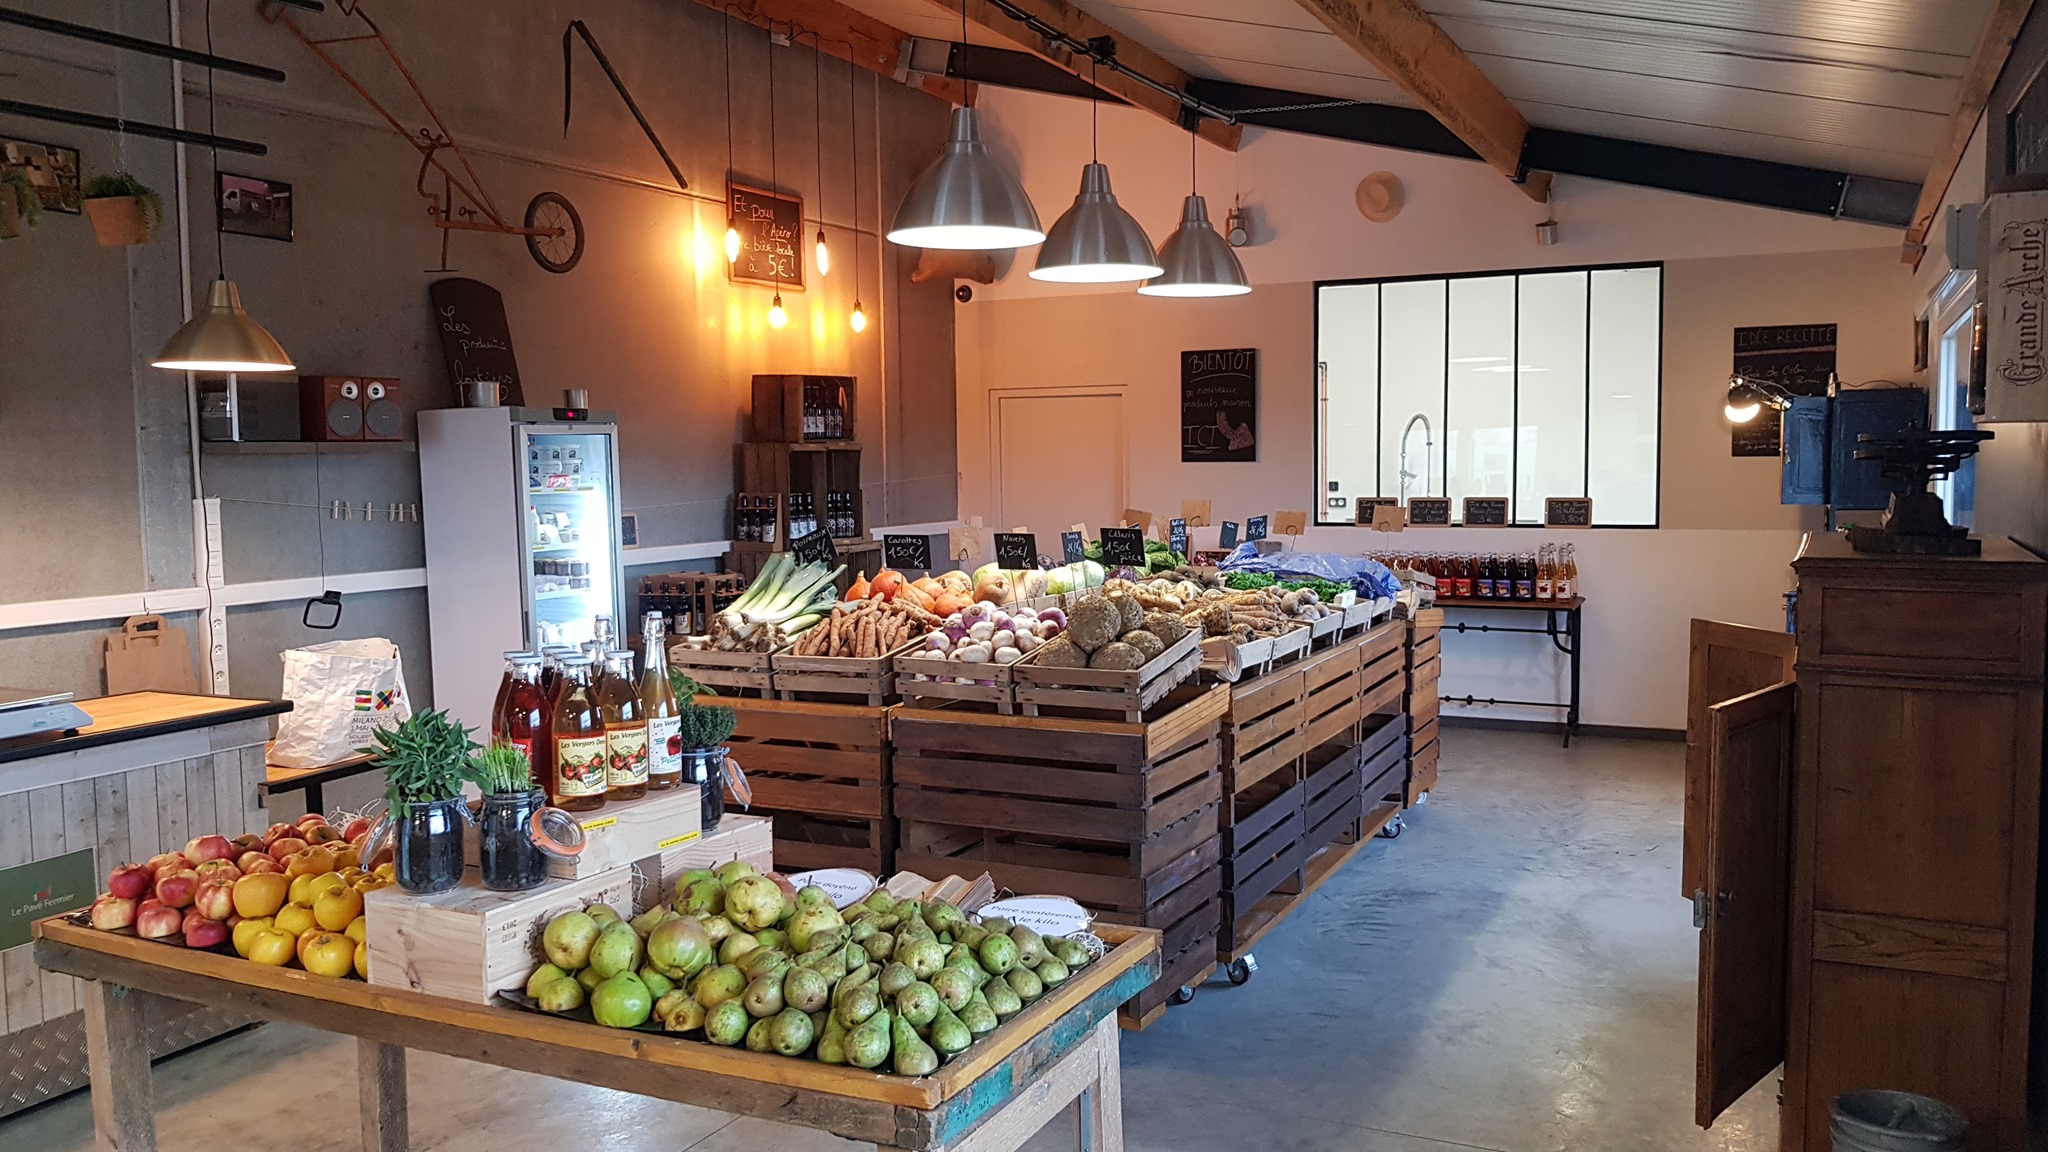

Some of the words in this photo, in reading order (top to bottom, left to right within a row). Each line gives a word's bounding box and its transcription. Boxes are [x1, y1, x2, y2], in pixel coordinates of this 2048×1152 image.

[733, 194, 747, 213] Et
[2000, 220, 2048, 299] Arche
[441, 304, 471, 335] Les
[1776, 326, 1836, 344] RECETTE
[1996, 300, 2048, 387] Grande
[1188, 349, 1254, 374] BIENTÔT
[1222, 398, 1252, 408] maison
[792, 528, 827, 549] Poireaux
[888, 535, 923, 545] Carottes
[1108, 529, 1136, 541] Céleris
[653, 721, 663, 729] Les
[610, 733, 620, 741] Les
[561, 741, 570, 749] Les
[798, 877, 822, 886] Pore
[11, 907, 22, 917] Le
[23, 901, 43, 914] Pavé
[44, 892, 75, 908] Fermier
[991, 905, 1019, 913] Poire
[1021, 908, 1082, 920] conférence
[1018, 915, 1031, 923] le
[1034, 916, 1060, 927] kilo
